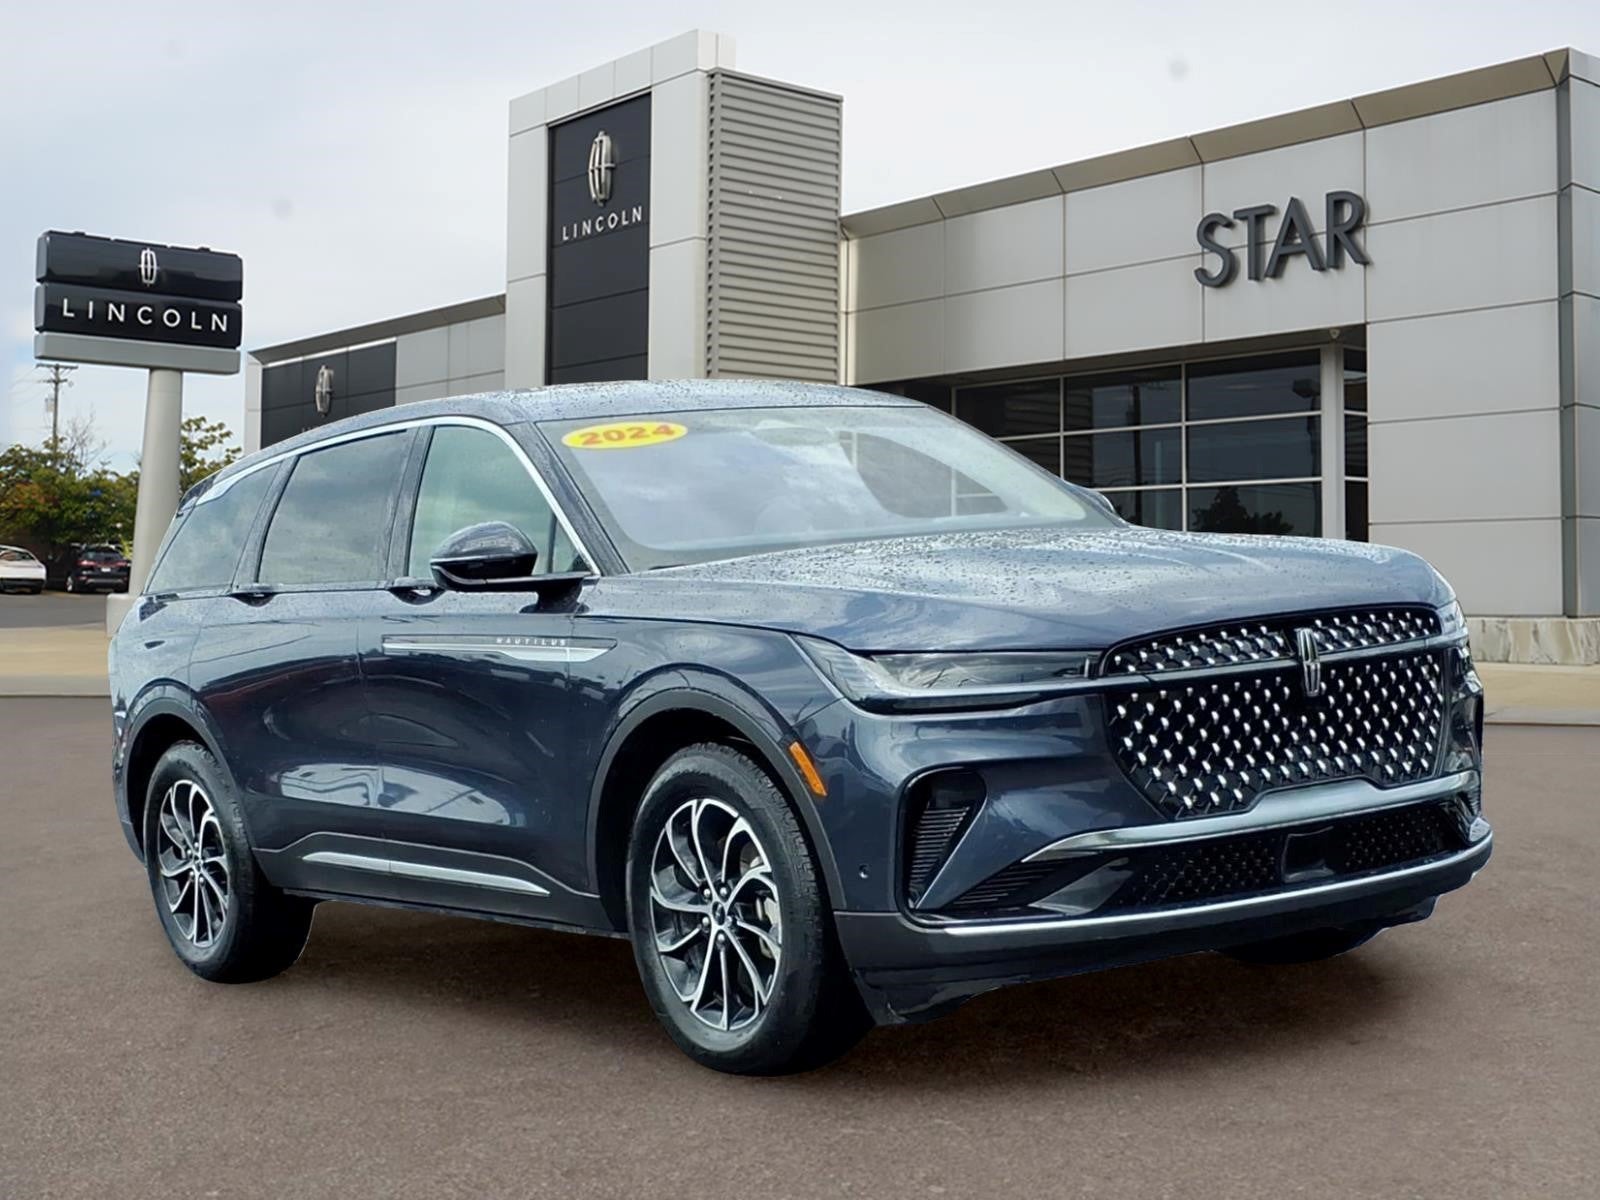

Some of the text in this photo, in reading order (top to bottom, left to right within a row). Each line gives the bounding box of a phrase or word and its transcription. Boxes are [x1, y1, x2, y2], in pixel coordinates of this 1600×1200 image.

[562, 205, 643, 241] LINCOLN
[1194, 190, 1370, 288] STAR
[62, 298, 228, 333] LINCOLN
[579, 424, 675, 446] 2024
[496, 637, 567, 647] NAUTILUS
